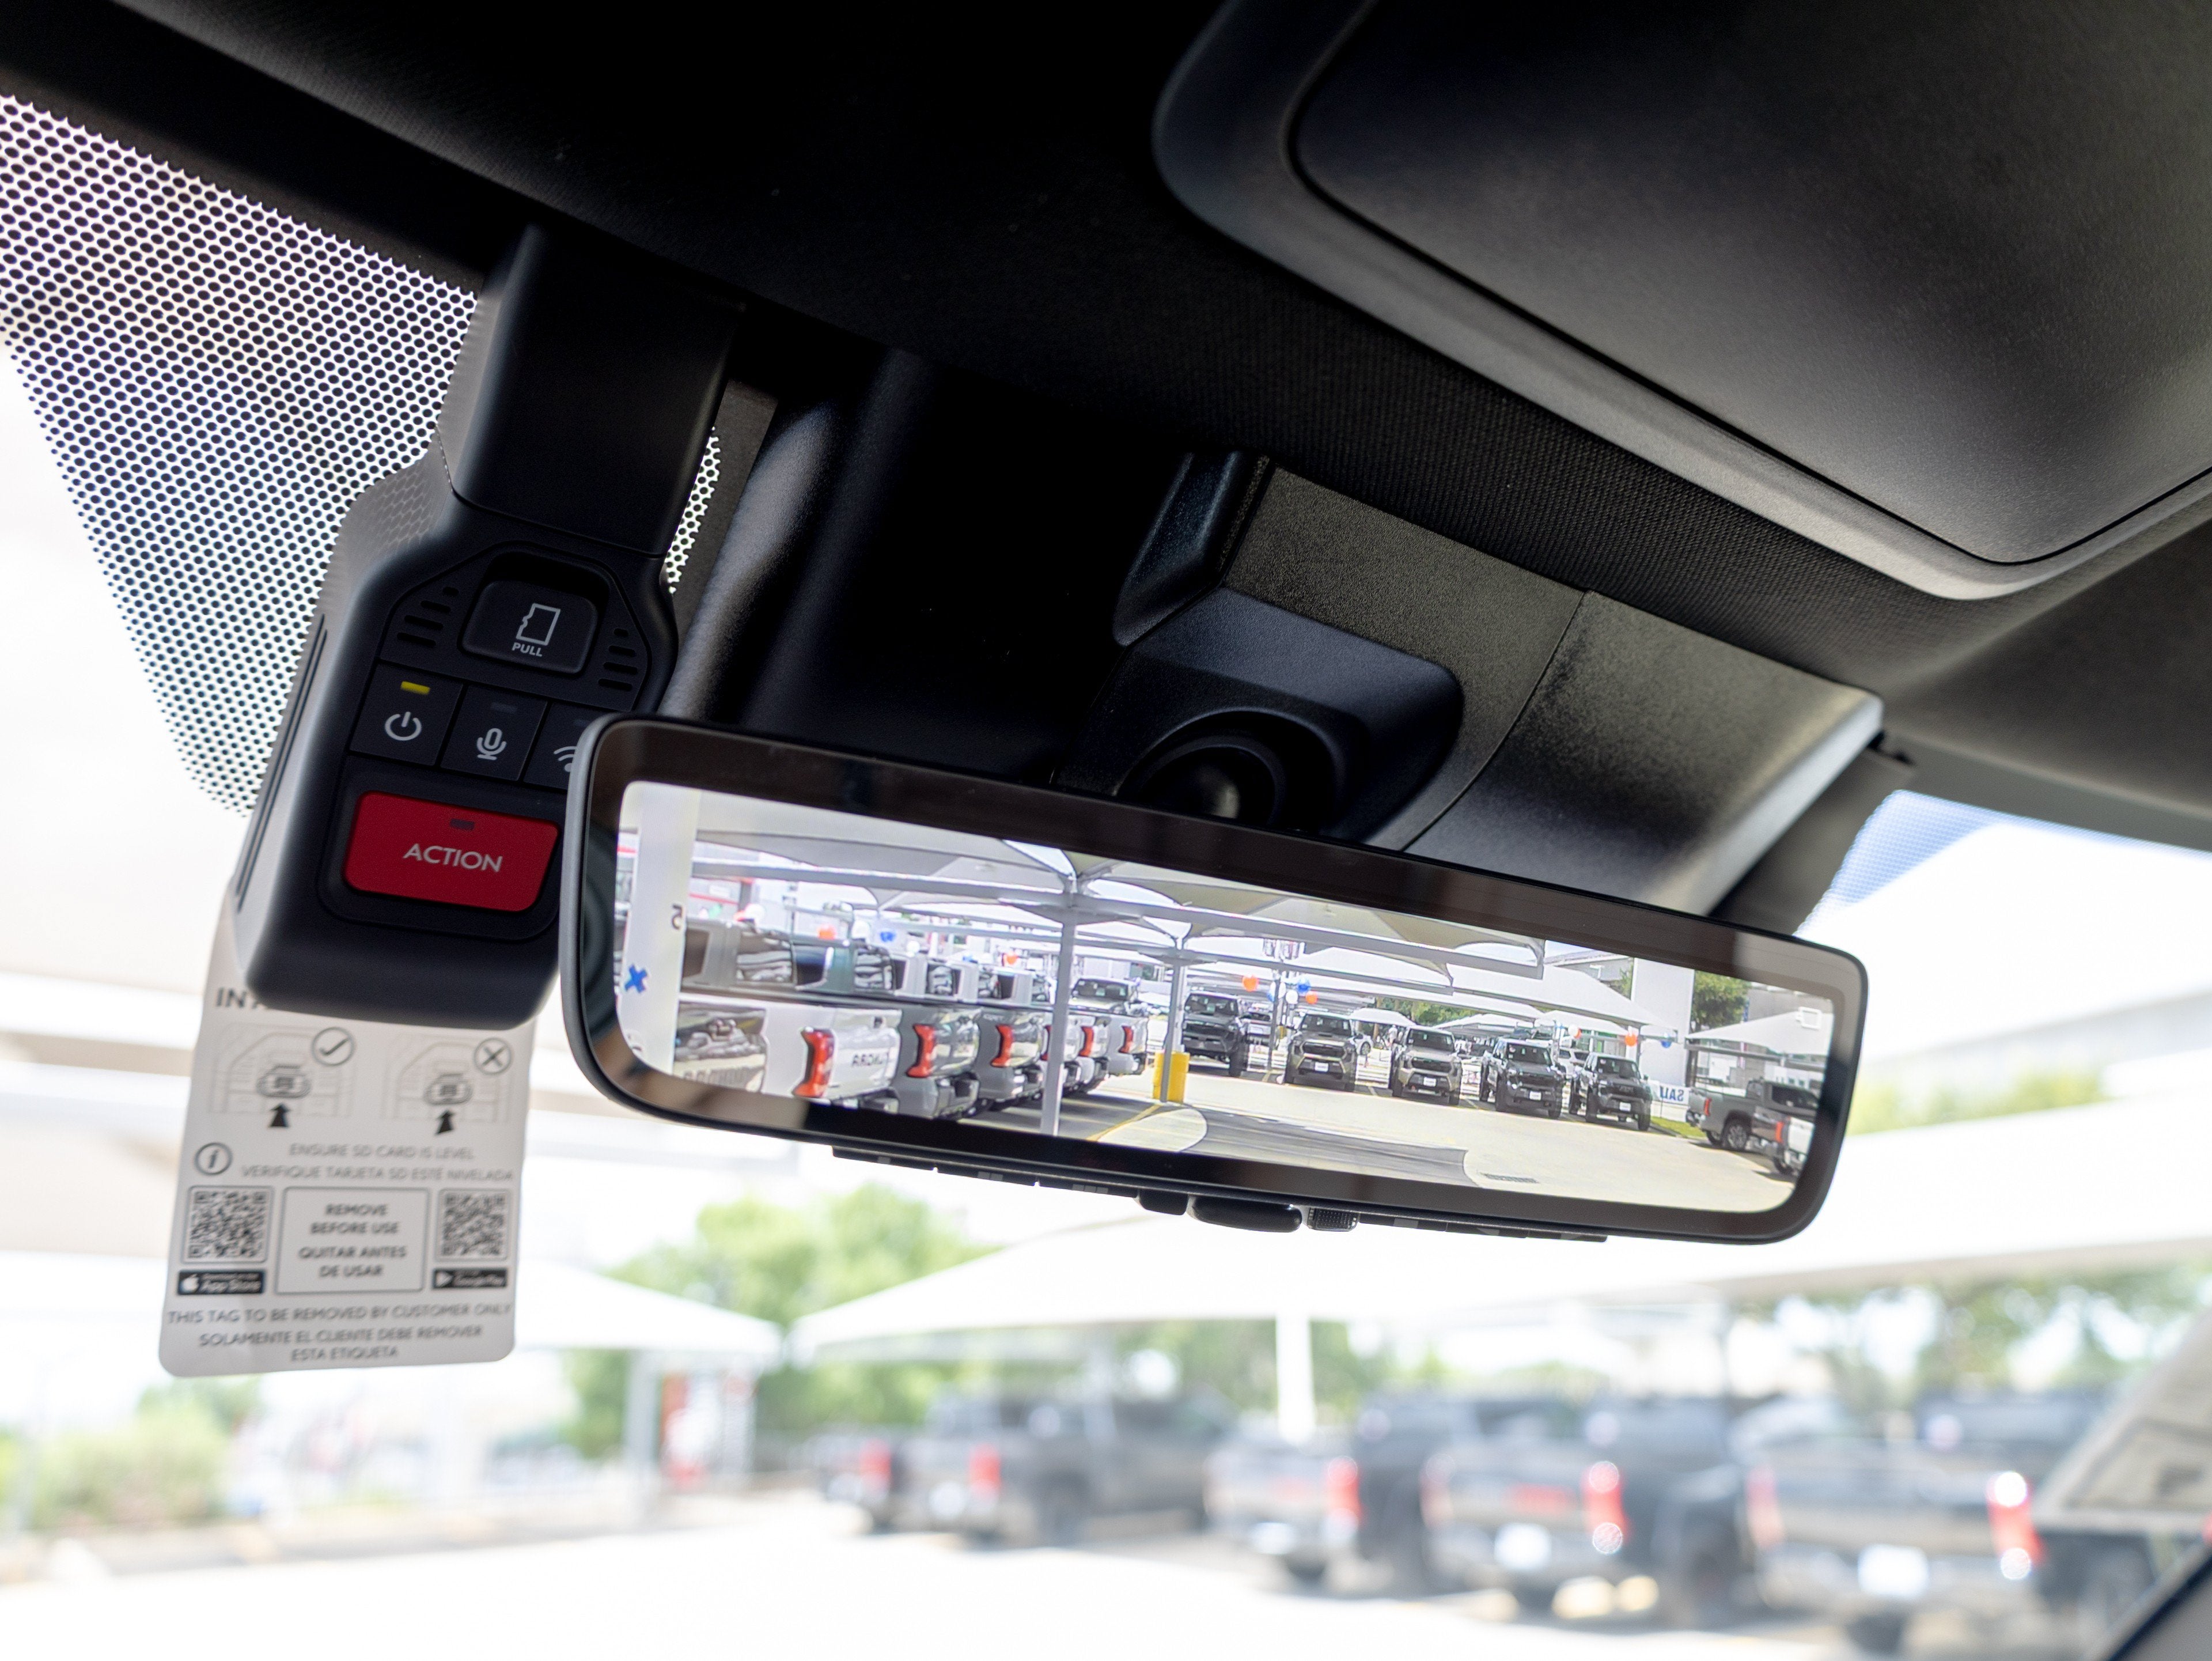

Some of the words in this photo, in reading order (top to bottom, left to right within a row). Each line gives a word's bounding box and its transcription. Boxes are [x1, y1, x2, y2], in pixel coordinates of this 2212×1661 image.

[512, 642, 543, 657] PULL
[403, 843, 503, 873] ACTION
[289, 1142, 349, 1156] ENSURE
[352, 1144, 372, 1157] SD
[376, 1145, 416, 1159] CARD
[420, 1146, 432, 1159] IS
[436, 1147, 476, 1160] LEVEL
[241, 1164, 321, 1179] VERIFIQUE
[326, 1166, 385, 1180] TARJETA
[388, 1167, 407, 1180] SD
[448, 1168, 513, 1182] NIVELADA
[324, 1203, 388, 1216] REMOVE
[310, 1221, 367, 1235] BEFORE
[372, 1221, 400, 1234] USE
[298, 1246, 357, 1259] QUITAR
[359, 1245, 408, 1258] ANTES
[319, 1265, 339, 1278] DE
[343, 1263, 384, 1277] USAR
[168, 1310, 203, 1323] THIS
[206, 1308, 241, 1323] TAG
[244, 1308, 267, 1322] TO
[270, 1307, 289, 1321] BE
[292, 1305, 367, 1321] REMOVED
[369, 1304, 389, 1319] BY
[391, 1302, 471, 1319] CUSTOMER
[474, 1302, 512, 1316] ONLY
[199, 1330, 293, 1346] SOLAMENTE
[296, 1329, 312, 1343] EL
[315, 1327, 374, 1343] CLIENTE
[376, 1327, 414, 1341] DEBE
[416, 1325, 483, 1340] REMOVER
[291, 1346, 327, 1361] ESTA
[330, 1345, 398, 1360] ETIQUETA
